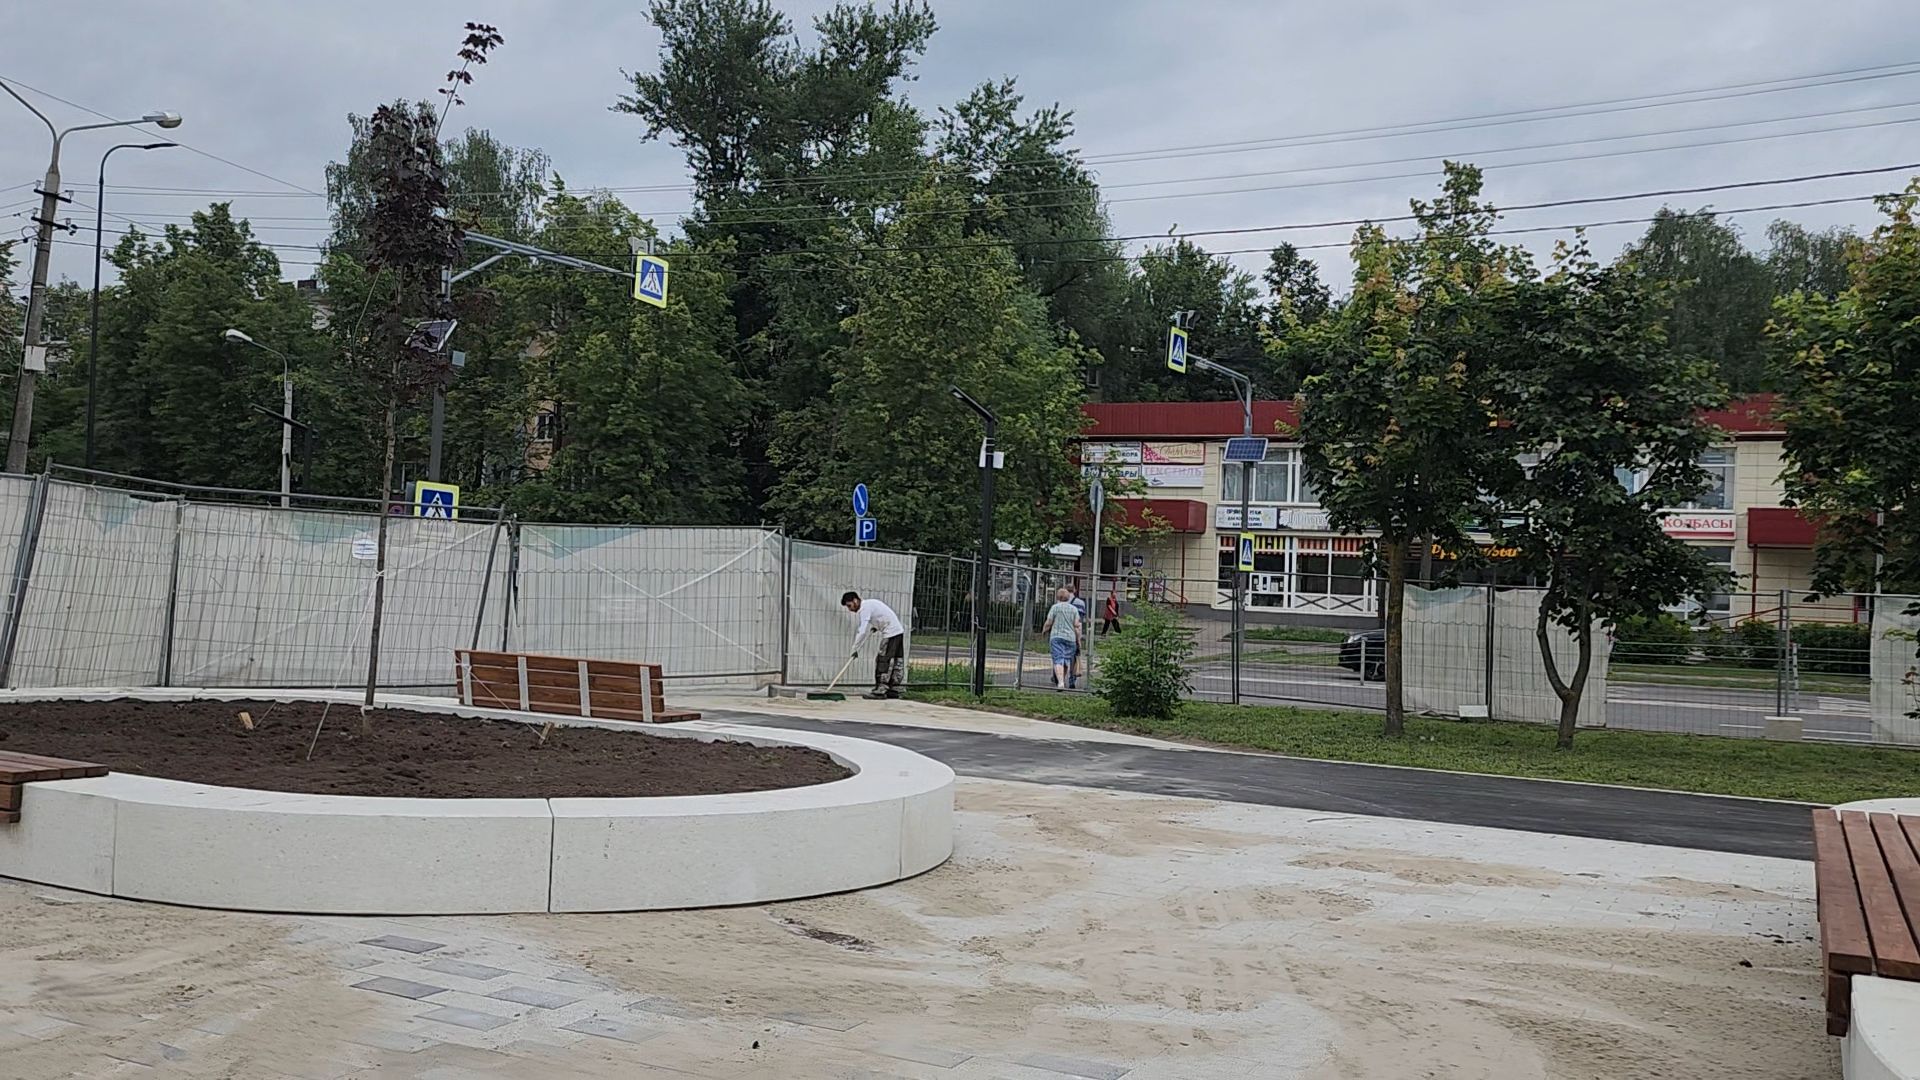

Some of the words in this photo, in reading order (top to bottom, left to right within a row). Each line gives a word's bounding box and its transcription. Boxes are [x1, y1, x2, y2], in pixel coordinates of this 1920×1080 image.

[1145, 467, 1202, 476] ТЕКСТИЛЬ
[1664, 518, 1732, 529] КОЛБАСЫ
[863, 521, 873, 538] P
